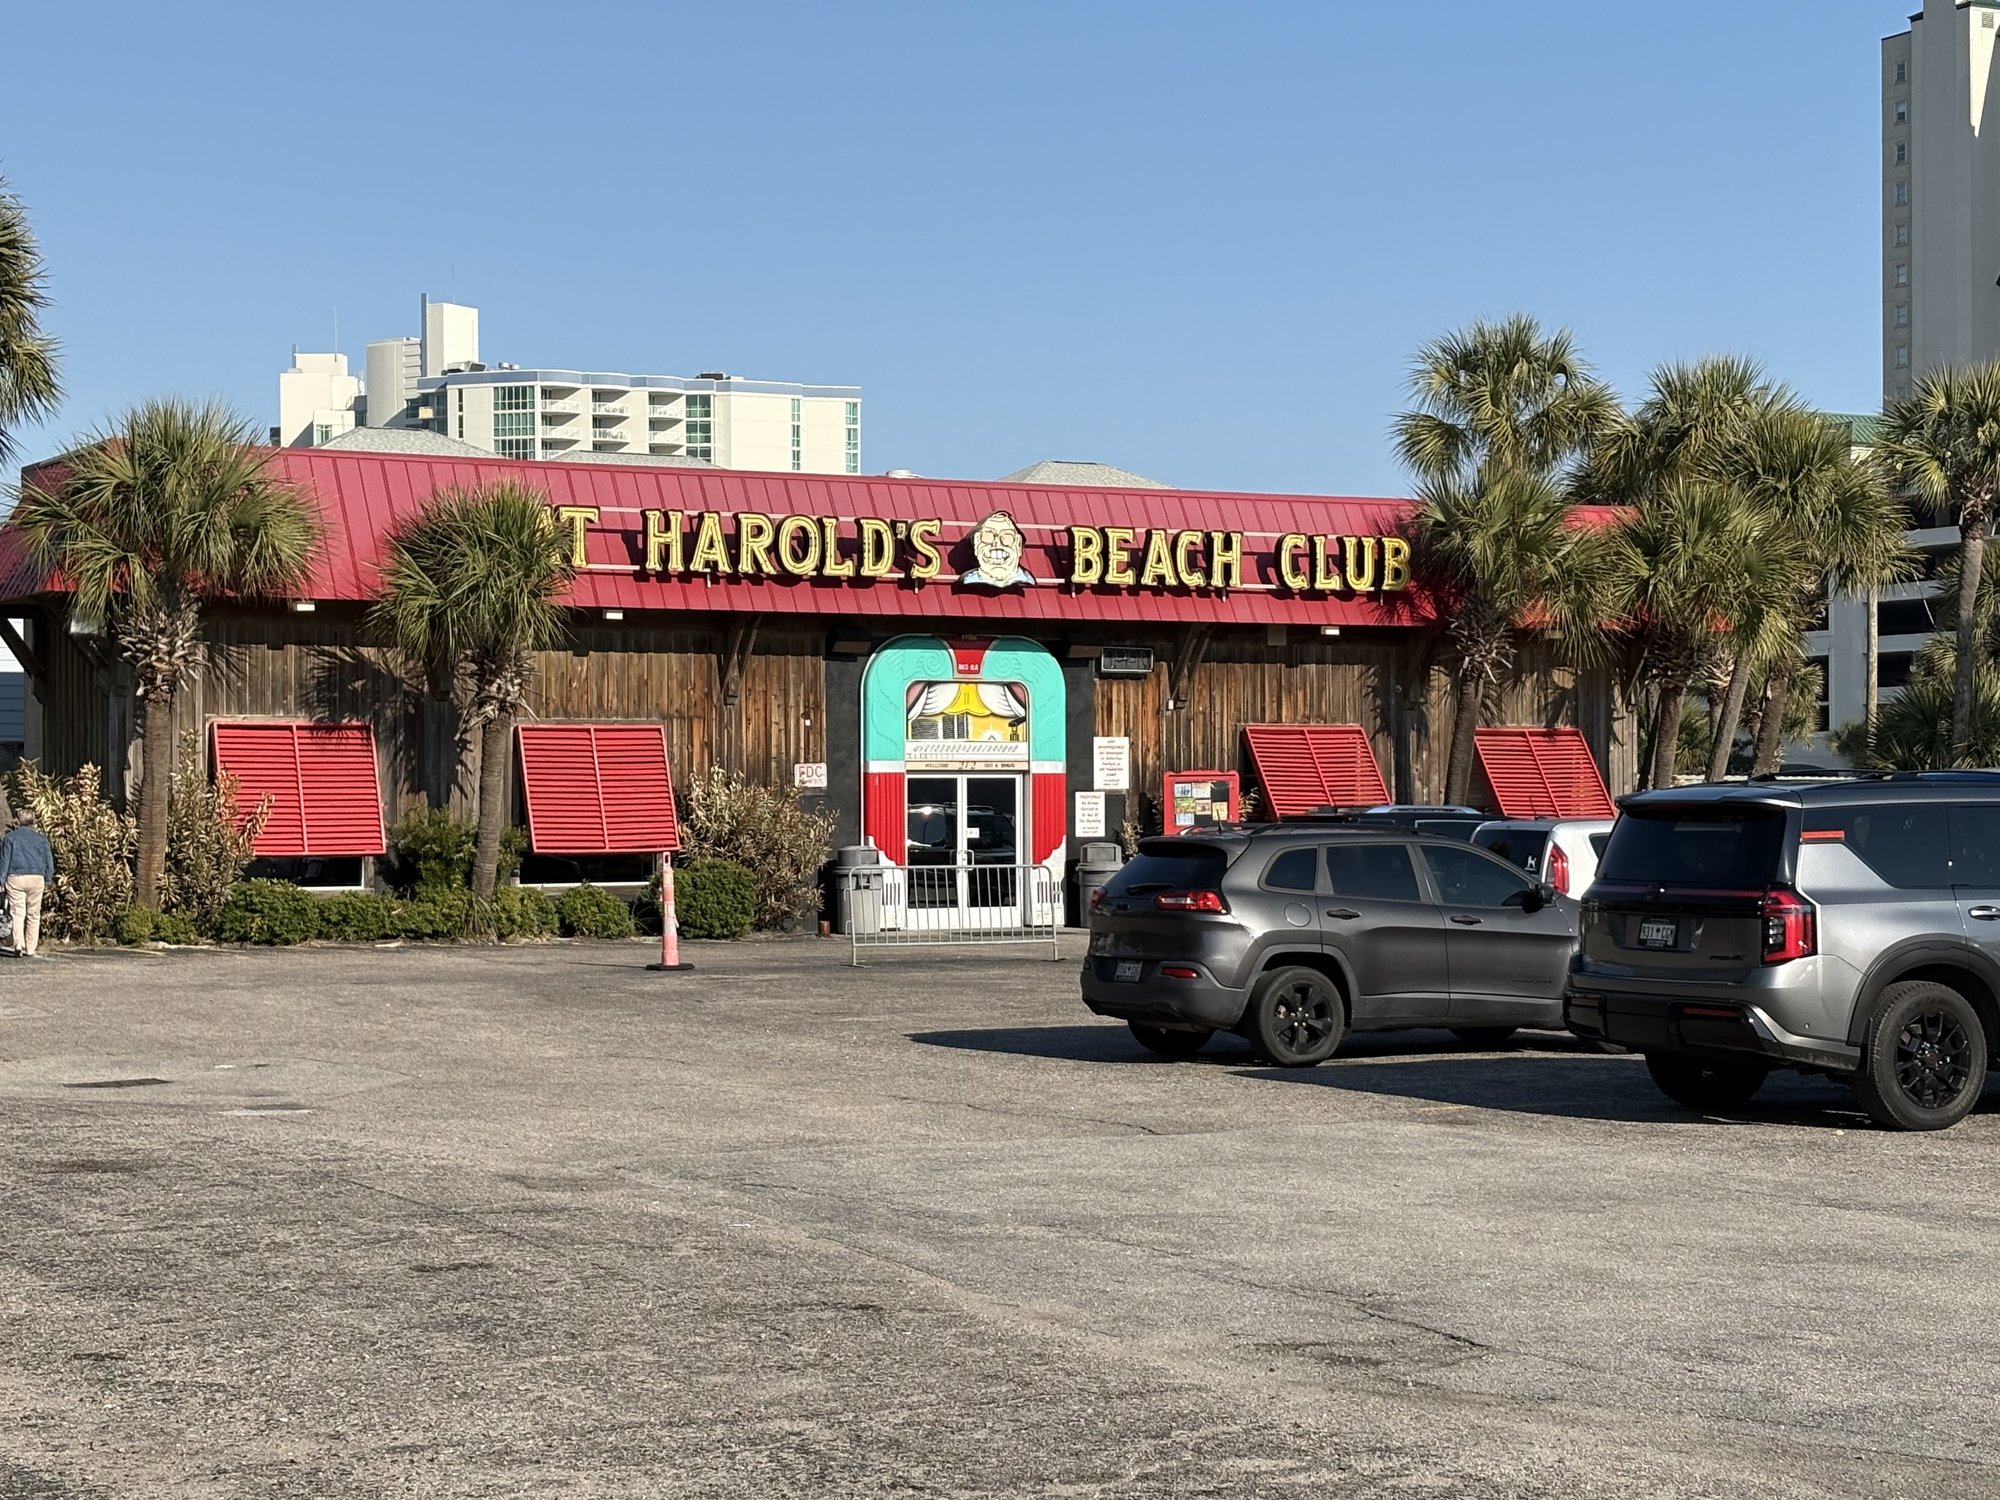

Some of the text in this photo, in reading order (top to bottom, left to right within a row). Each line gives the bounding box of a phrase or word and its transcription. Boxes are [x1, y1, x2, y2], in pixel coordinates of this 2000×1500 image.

[643, 509, 942, 579] HAROLD'S
[1070, 526, 1242, 587] BEACH
[1280, 533, 1412, 591] CLUB
[799, 765, 823, 778] FDC
